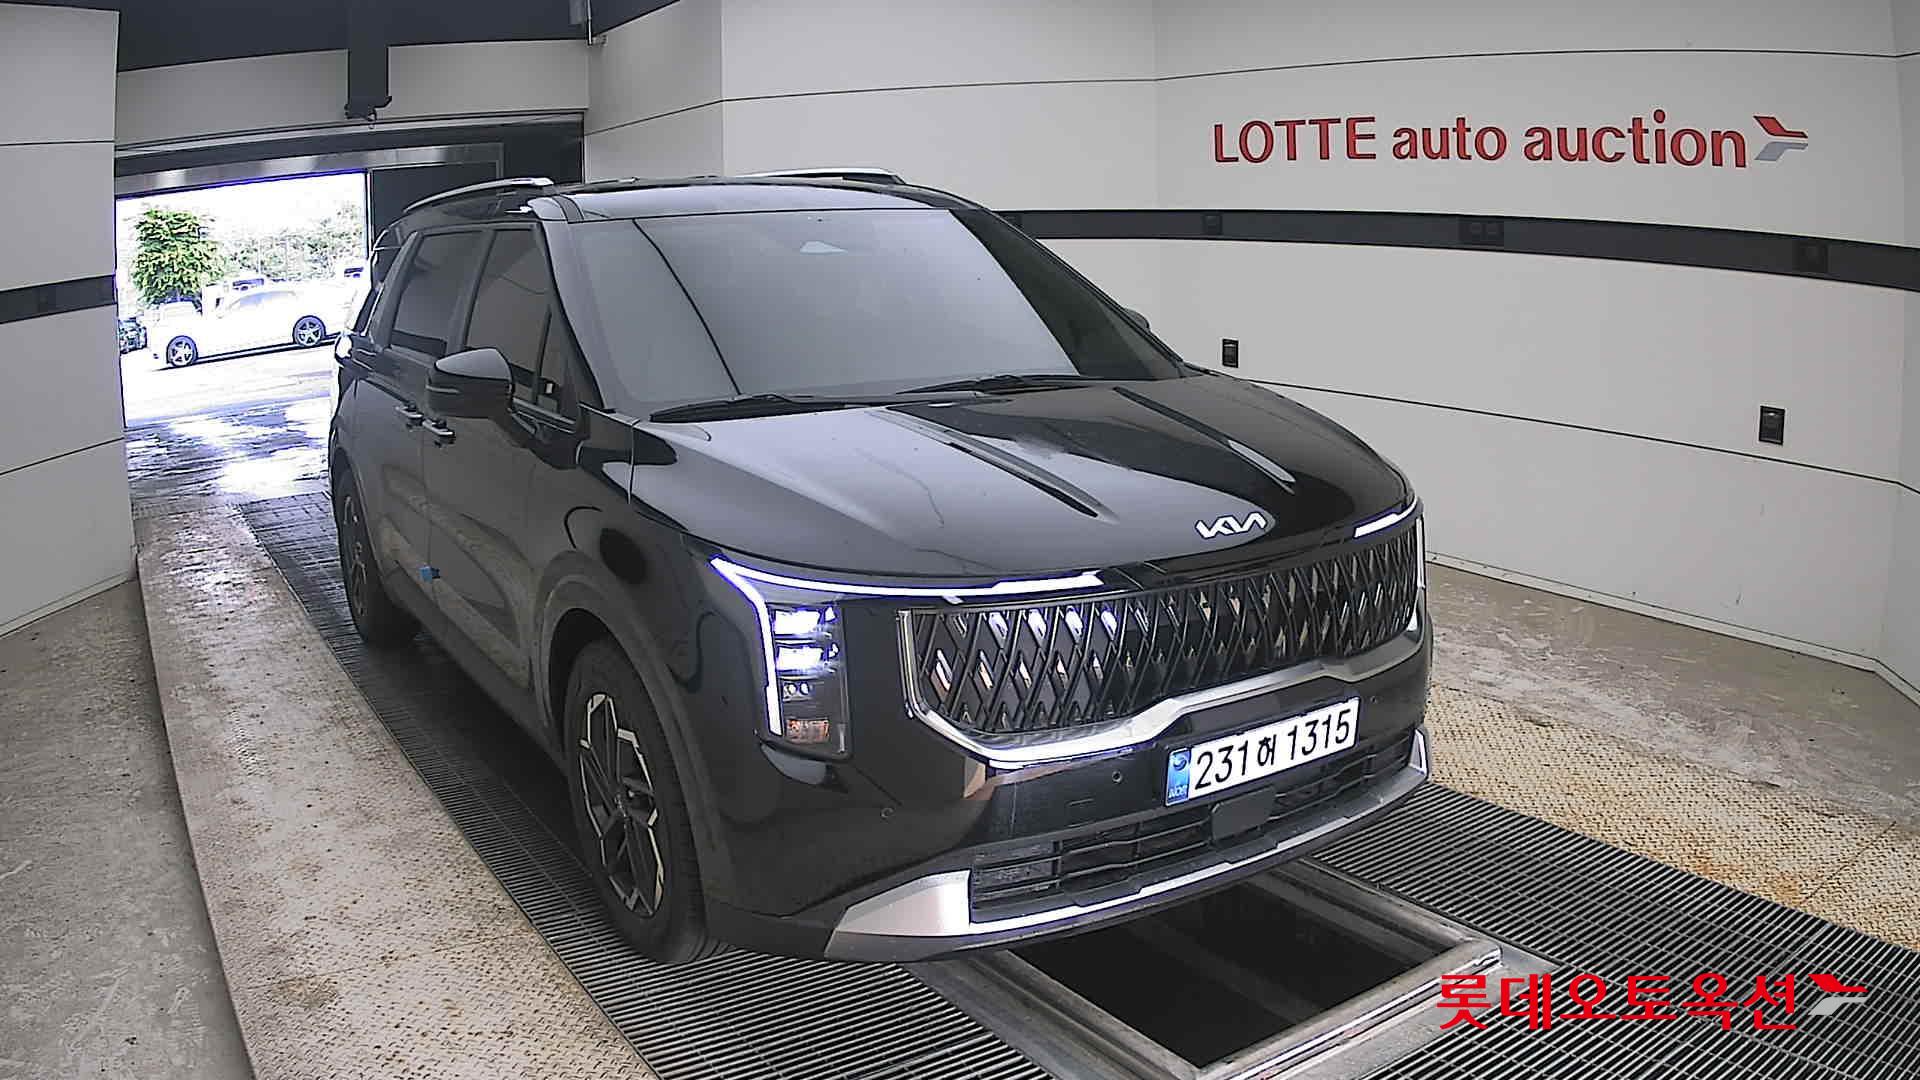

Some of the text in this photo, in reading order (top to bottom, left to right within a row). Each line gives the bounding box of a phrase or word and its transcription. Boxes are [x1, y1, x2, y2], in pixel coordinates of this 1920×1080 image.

[1213, 109, 1747, 168] LOTTE auto auction
[1287, 709, 1352, 761] 1315
